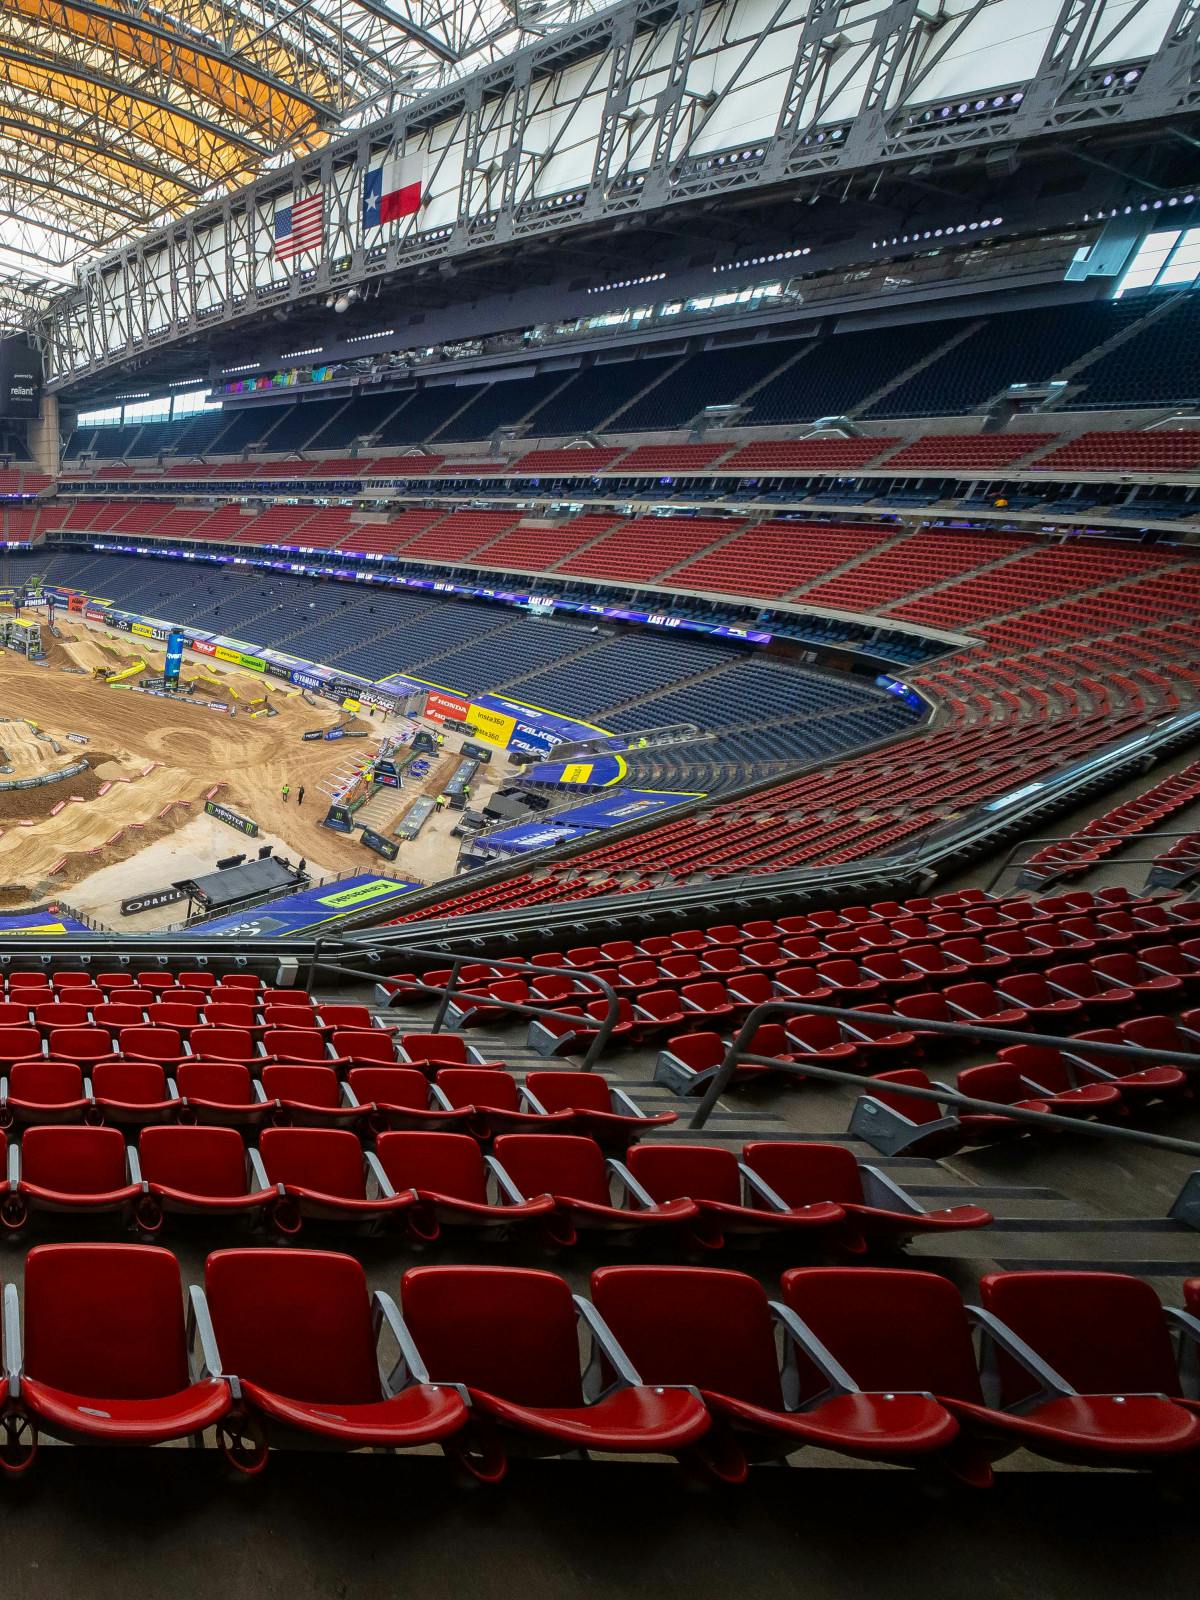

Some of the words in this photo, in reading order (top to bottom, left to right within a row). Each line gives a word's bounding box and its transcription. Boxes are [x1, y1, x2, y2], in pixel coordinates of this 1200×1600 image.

[10, 386, 34, 395] reliant
[24, 598, 47, 607] FINISH
[646, 614, 666, 625] LAST
[664, 617, 681, 628] LAP
[299, 674, 320, 687] YAMAHA
[437, 698, 467, 713] HONDA
[477, 711, 505, 727] Insta360
[214, 806, 245, 828] MONSTER
